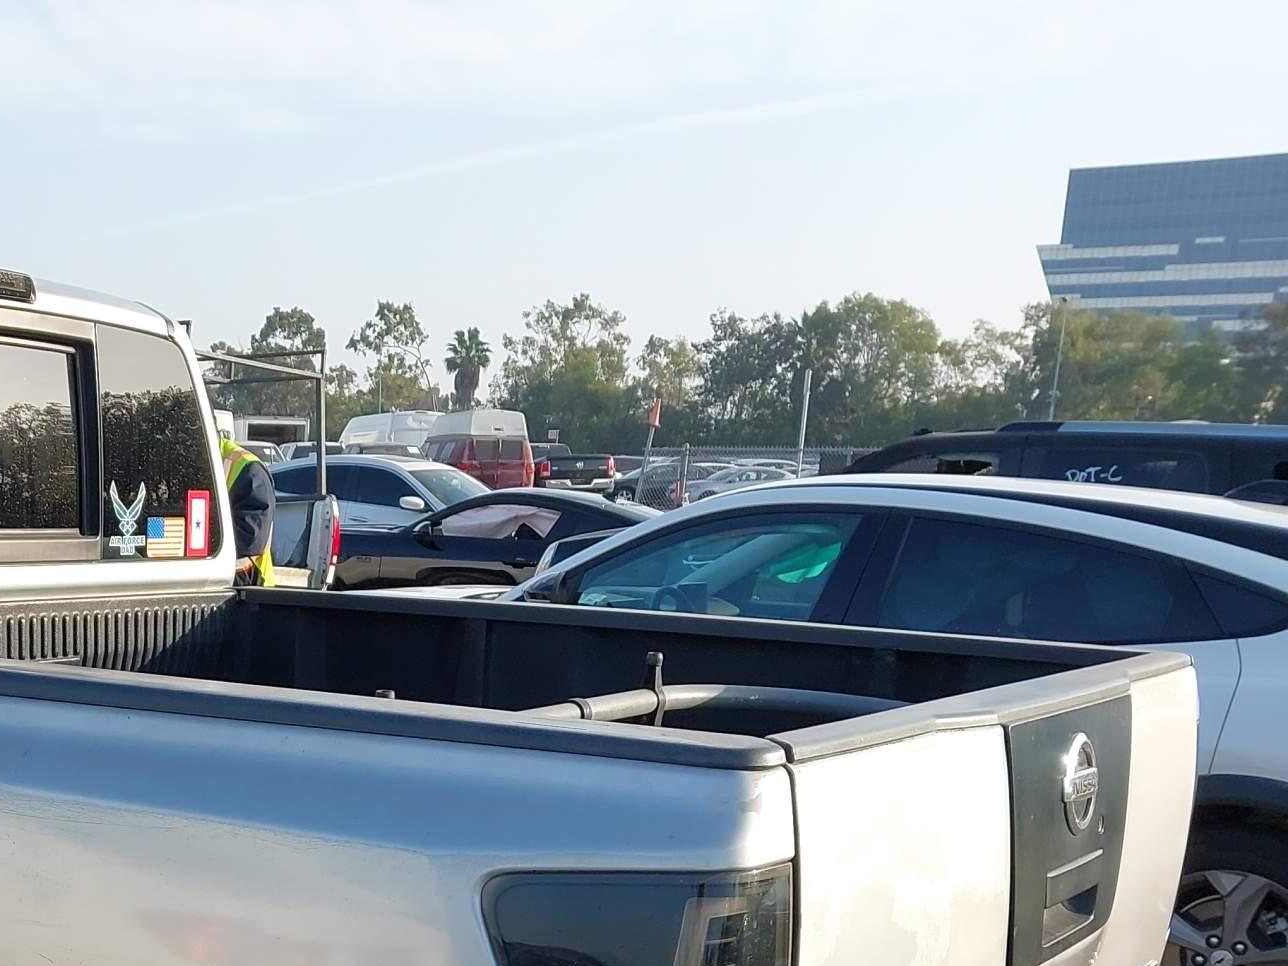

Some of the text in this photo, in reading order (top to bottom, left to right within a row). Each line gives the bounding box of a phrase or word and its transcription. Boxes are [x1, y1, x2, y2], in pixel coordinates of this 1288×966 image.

[110, 536, 145, 545] AIR FORCE
[121, 545, 134, 554] DAD
